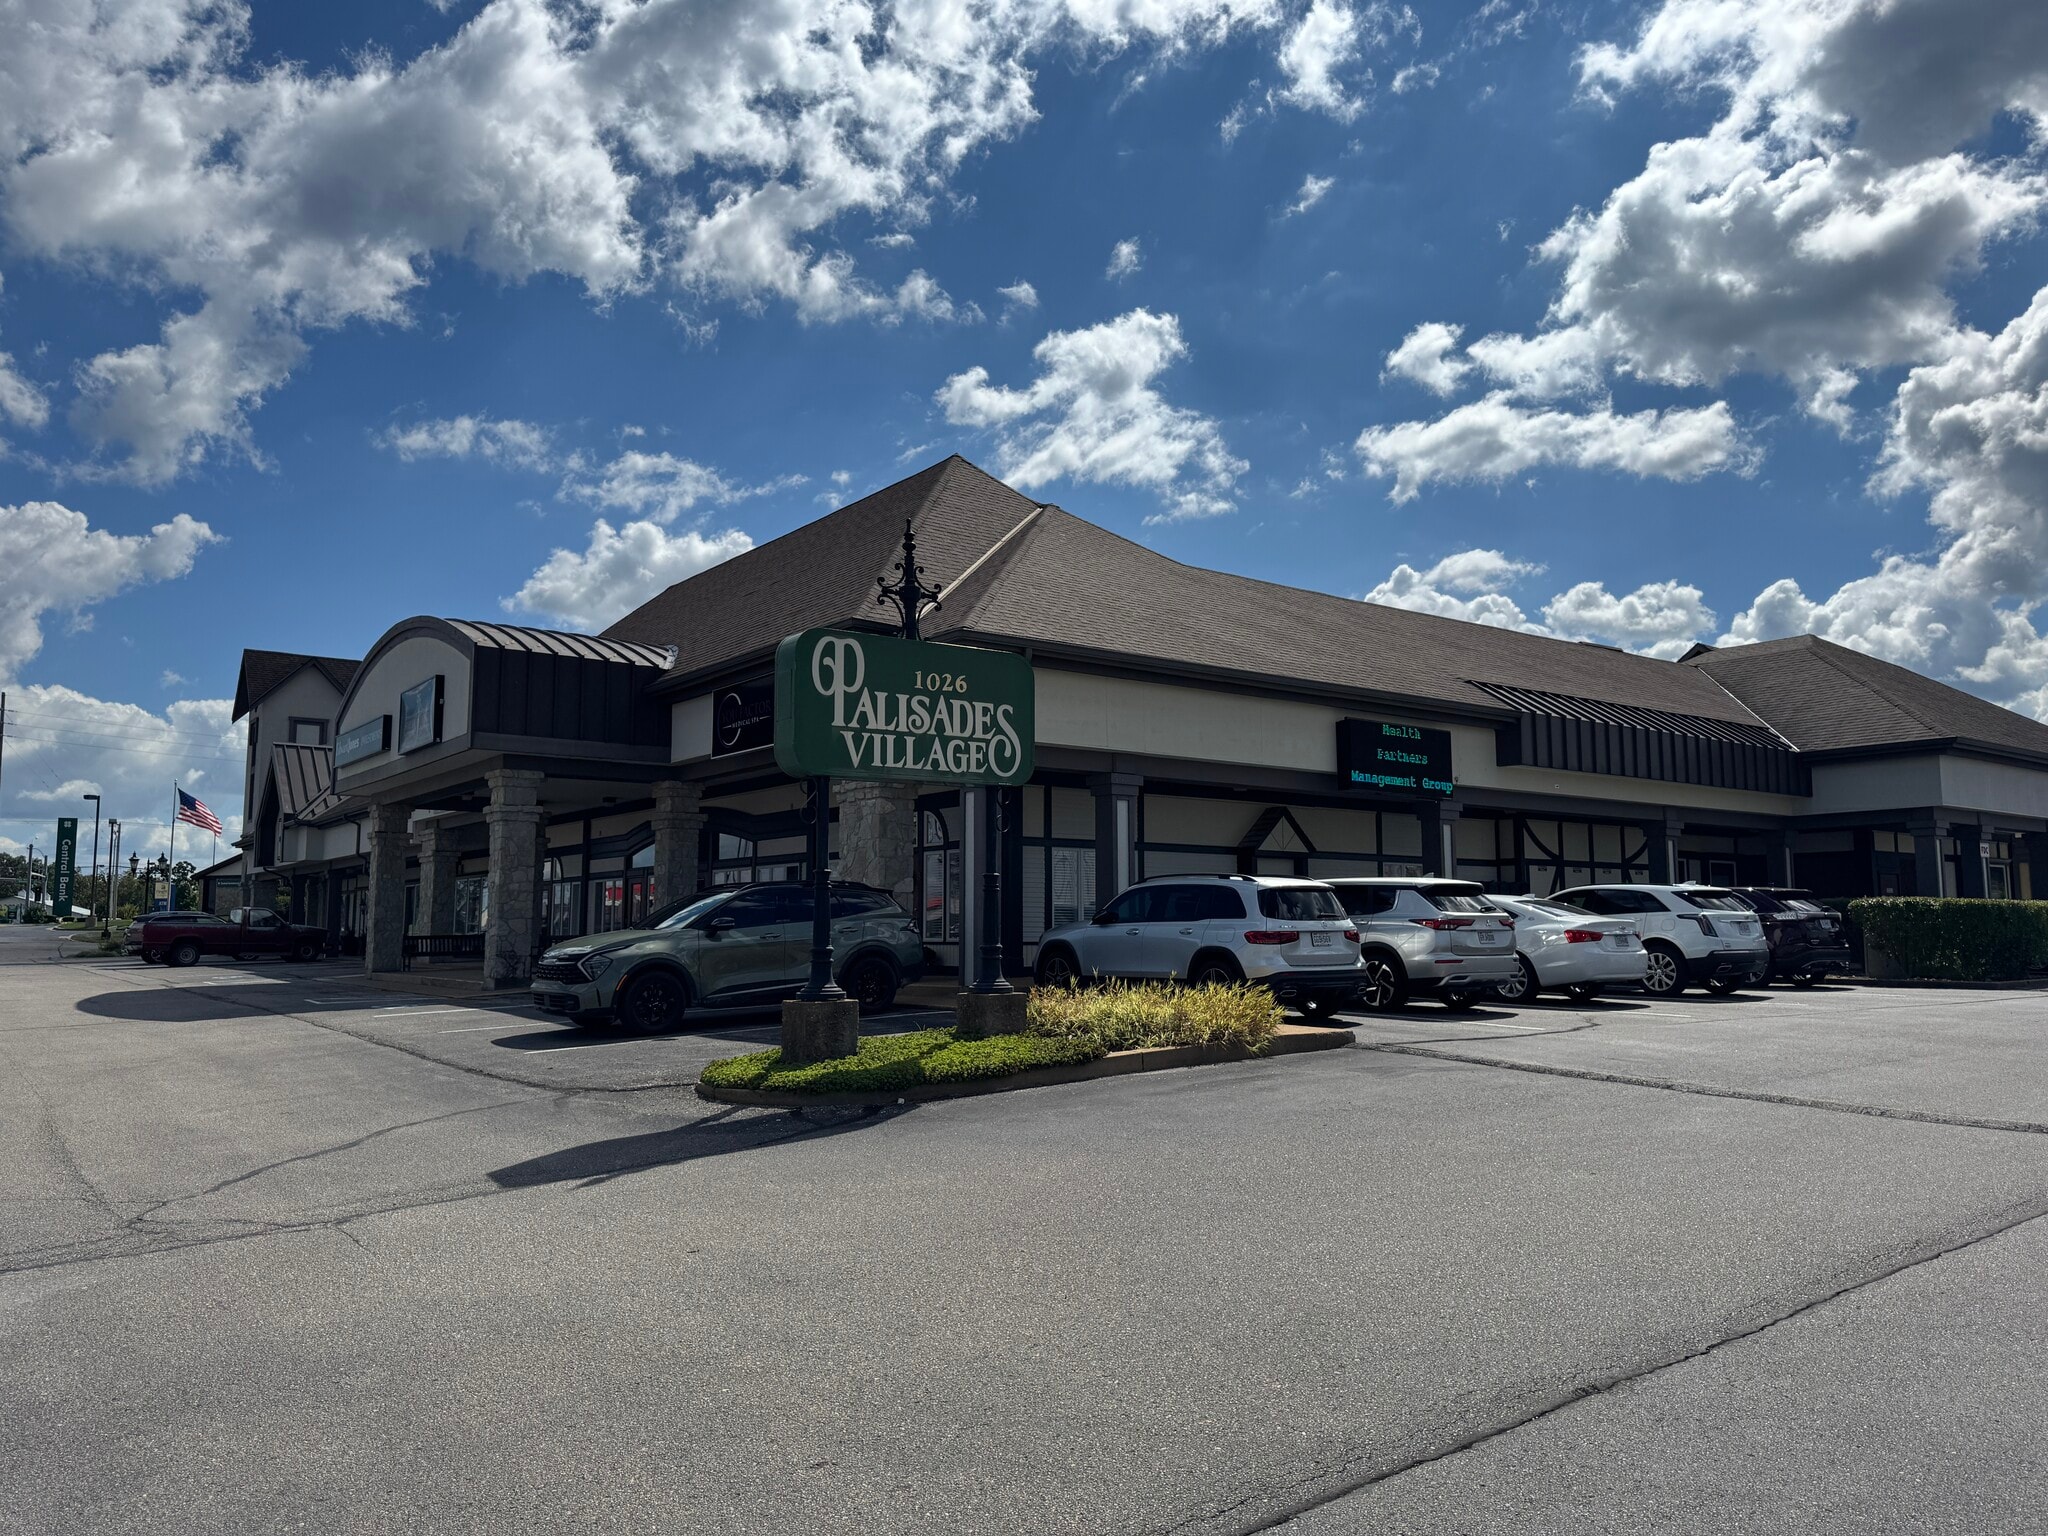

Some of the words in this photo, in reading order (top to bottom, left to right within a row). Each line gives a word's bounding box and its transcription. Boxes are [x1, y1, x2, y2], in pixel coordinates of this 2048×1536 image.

[914, 670, 968, 693] 1026
[811, 635, 1021, 777] PALISADES
[1382, 724, 1421, 739] Health
[840, 731, 988, 774] VILLAGE
[1377, 748, 1428, 764] Partners
[1351, 770, 1416, 788] Management
[1422, 777, 1453, 794] Group
[60, 839, 71, 873] Central
[58, 876, 69, 902] Bank
